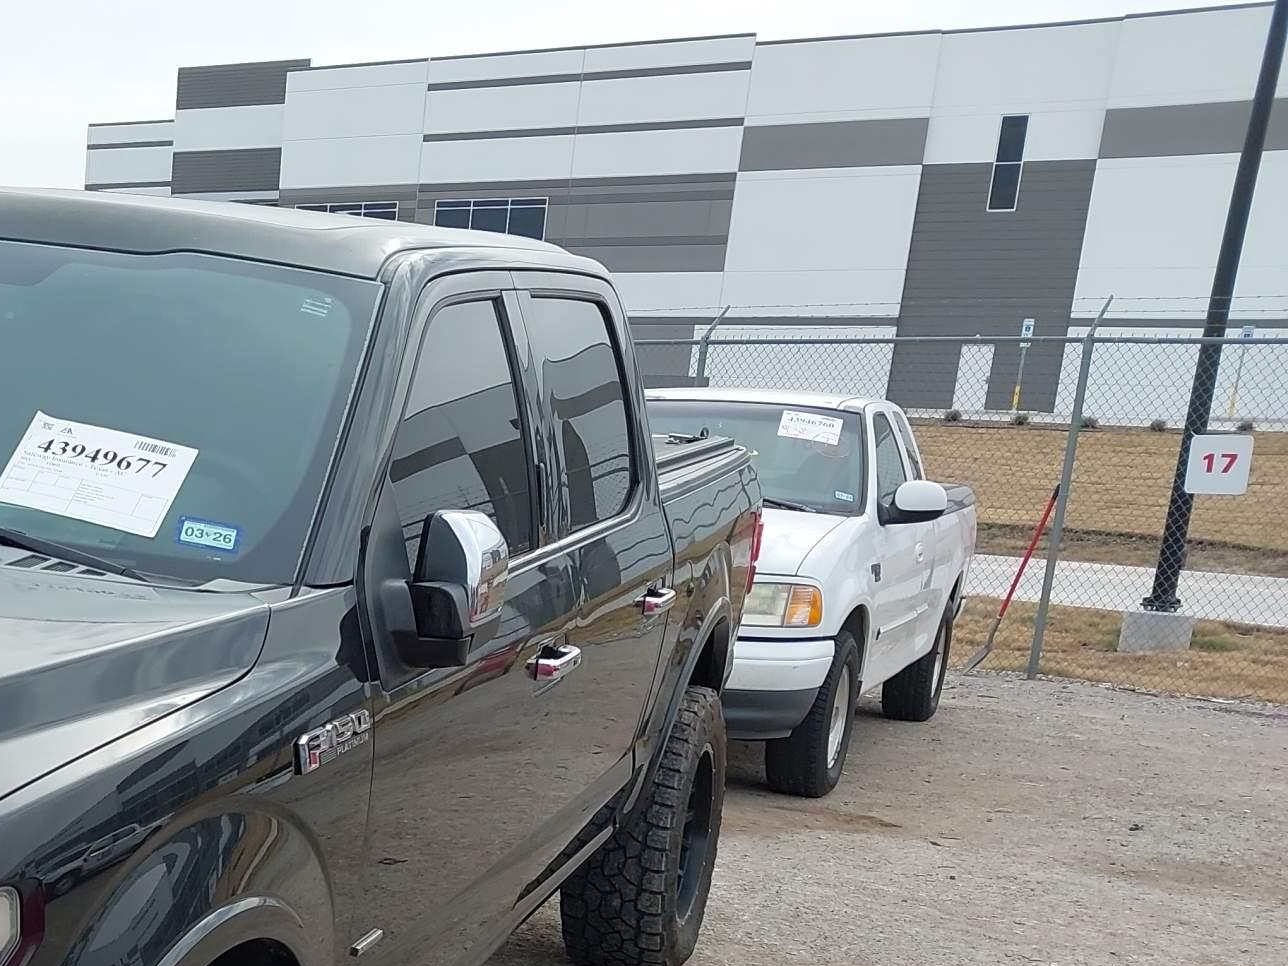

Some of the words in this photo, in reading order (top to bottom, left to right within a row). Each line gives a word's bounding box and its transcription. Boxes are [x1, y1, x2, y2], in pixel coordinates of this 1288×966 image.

[37, 438, 169, 478] 43949677
[1203, 453, 1239, 473] 17
[184, 526, 204, 539] 03
[212, 531, 233, 544] 26
